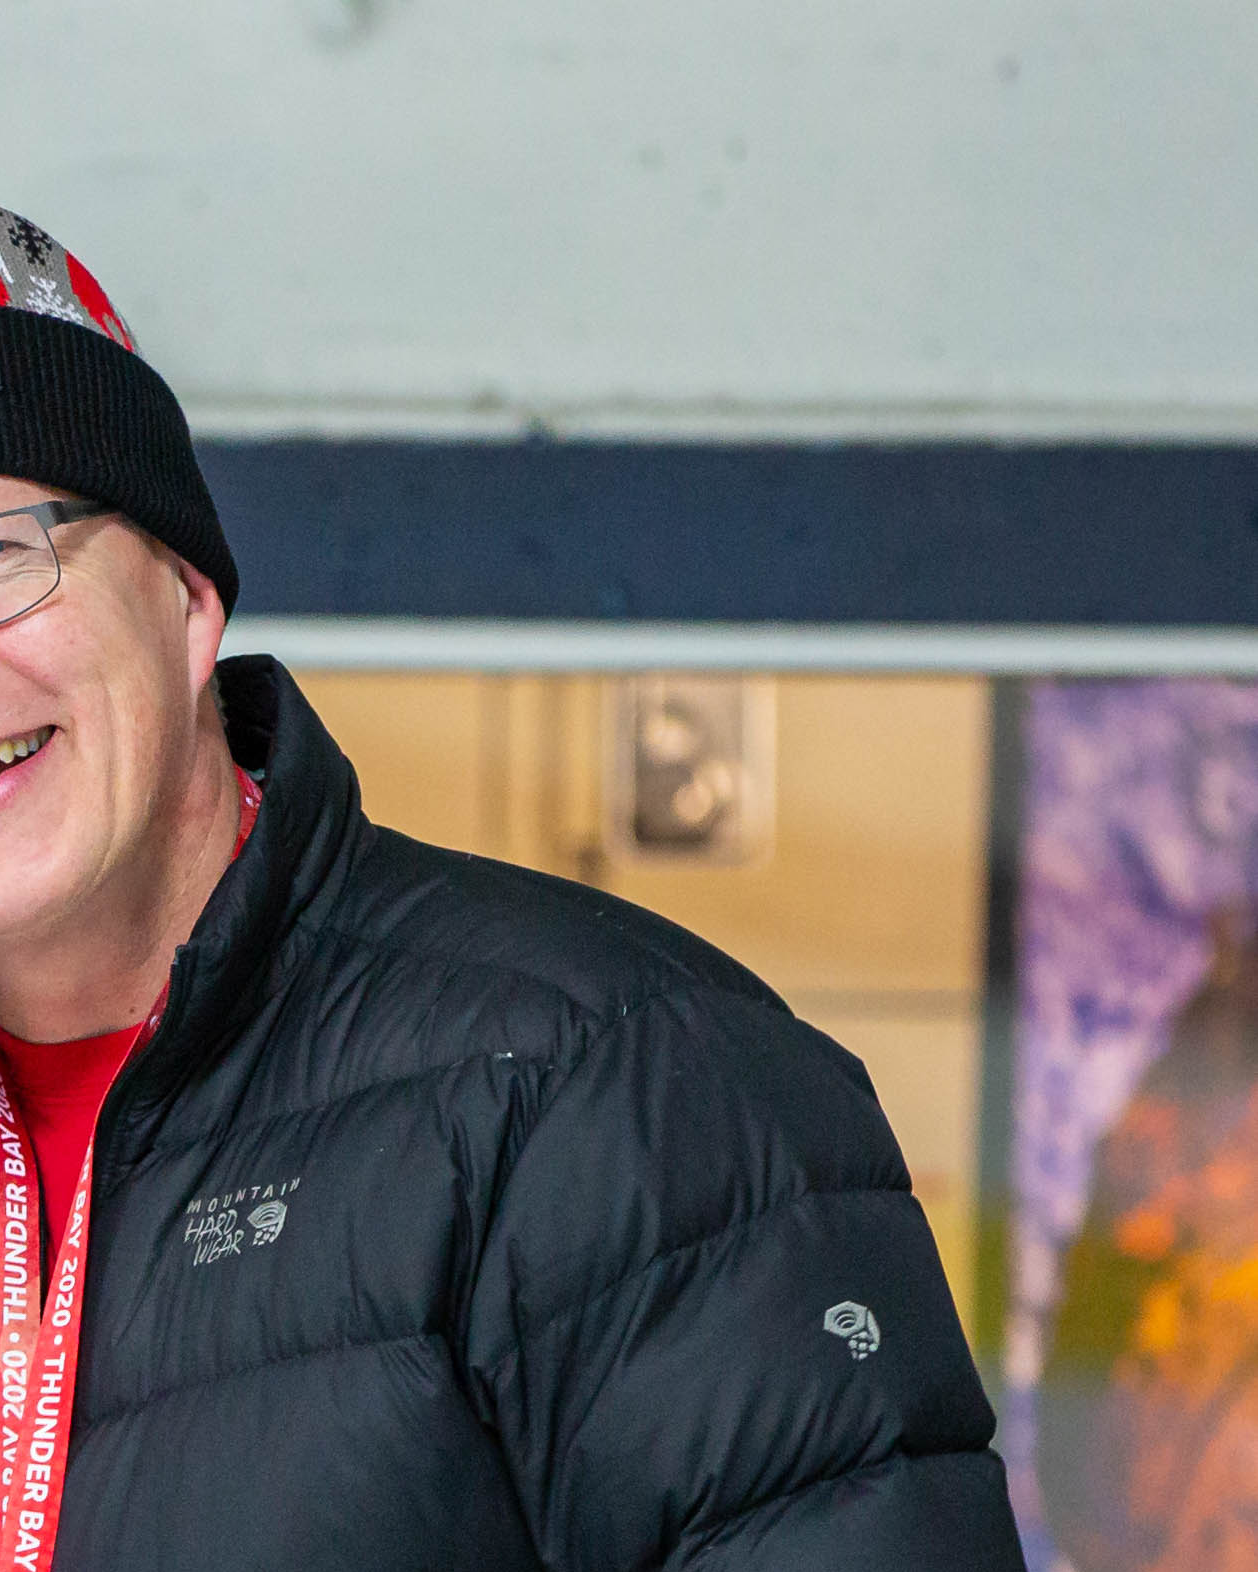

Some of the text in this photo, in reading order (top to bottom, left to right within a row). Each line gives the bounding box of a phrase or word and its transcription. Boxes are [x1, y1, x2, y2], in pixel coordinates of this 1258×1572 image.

[69, 1190, 86, 1249] BAY
[184, 1209, 238, 1243] HARD
[187, 1177, 300, 1214] MOUNTAIN
[2, 1183, 27, 1327] THUNDER
[194, 1229, 244, 1267] WEAR
[52, 1256, 78, 1327] 2020
[2, 1350, 27, 1420] 2020
[22, 1352, 65, 1502] THUNDER
[13, 1510, 44, 1572] BAY
